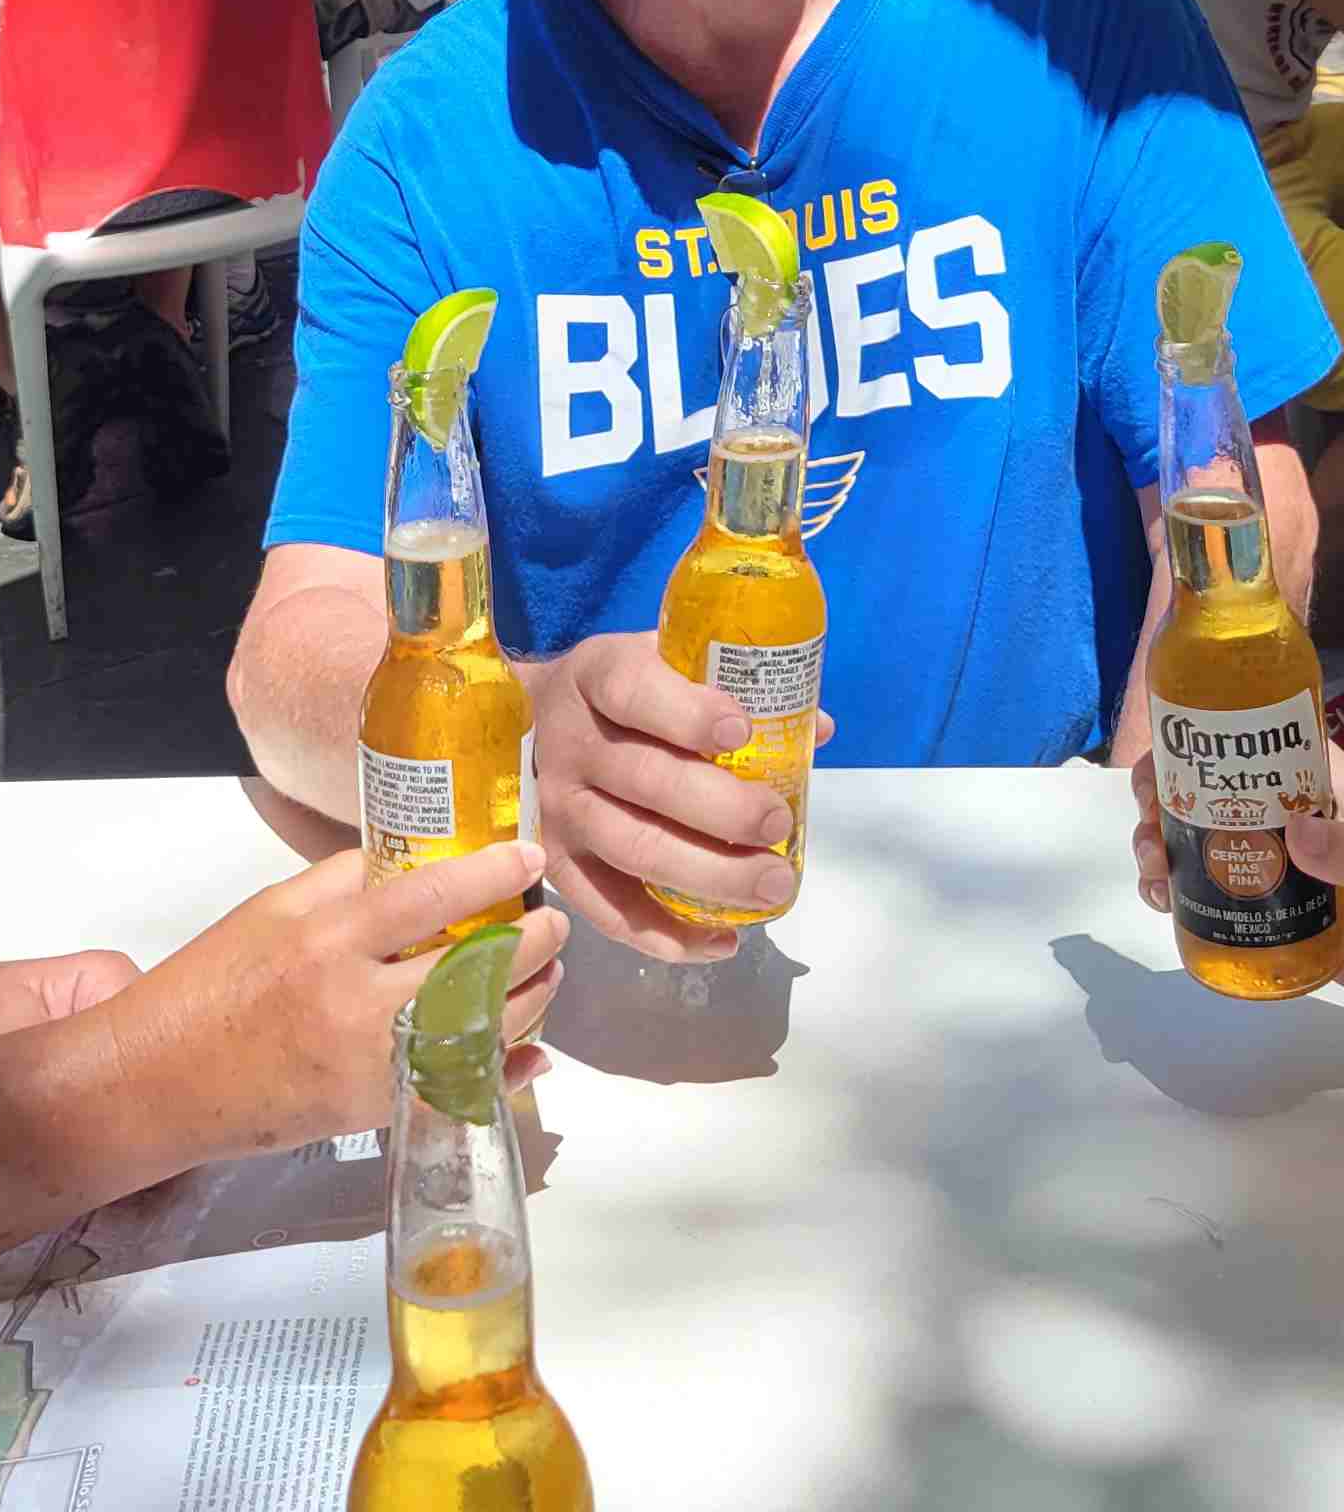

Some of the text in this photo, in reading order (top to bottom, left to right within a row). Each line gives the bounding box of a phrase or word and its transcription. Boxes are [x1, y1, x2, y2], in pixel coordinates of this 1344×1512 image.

[635, 178, 900, 279] ST. UIS
[1160, 714, 1304, 767] Corona
[1196, 760, 1283, 792] Extra
[1210, 849, 1276, 862] CERVEZA
[1230, 839, 1251, 851] LA
[1228, 863, 1259, 875] MAS
[1229, 874, 1263, 886] FINA
[79, 1442, 104, 1496] Castillo
